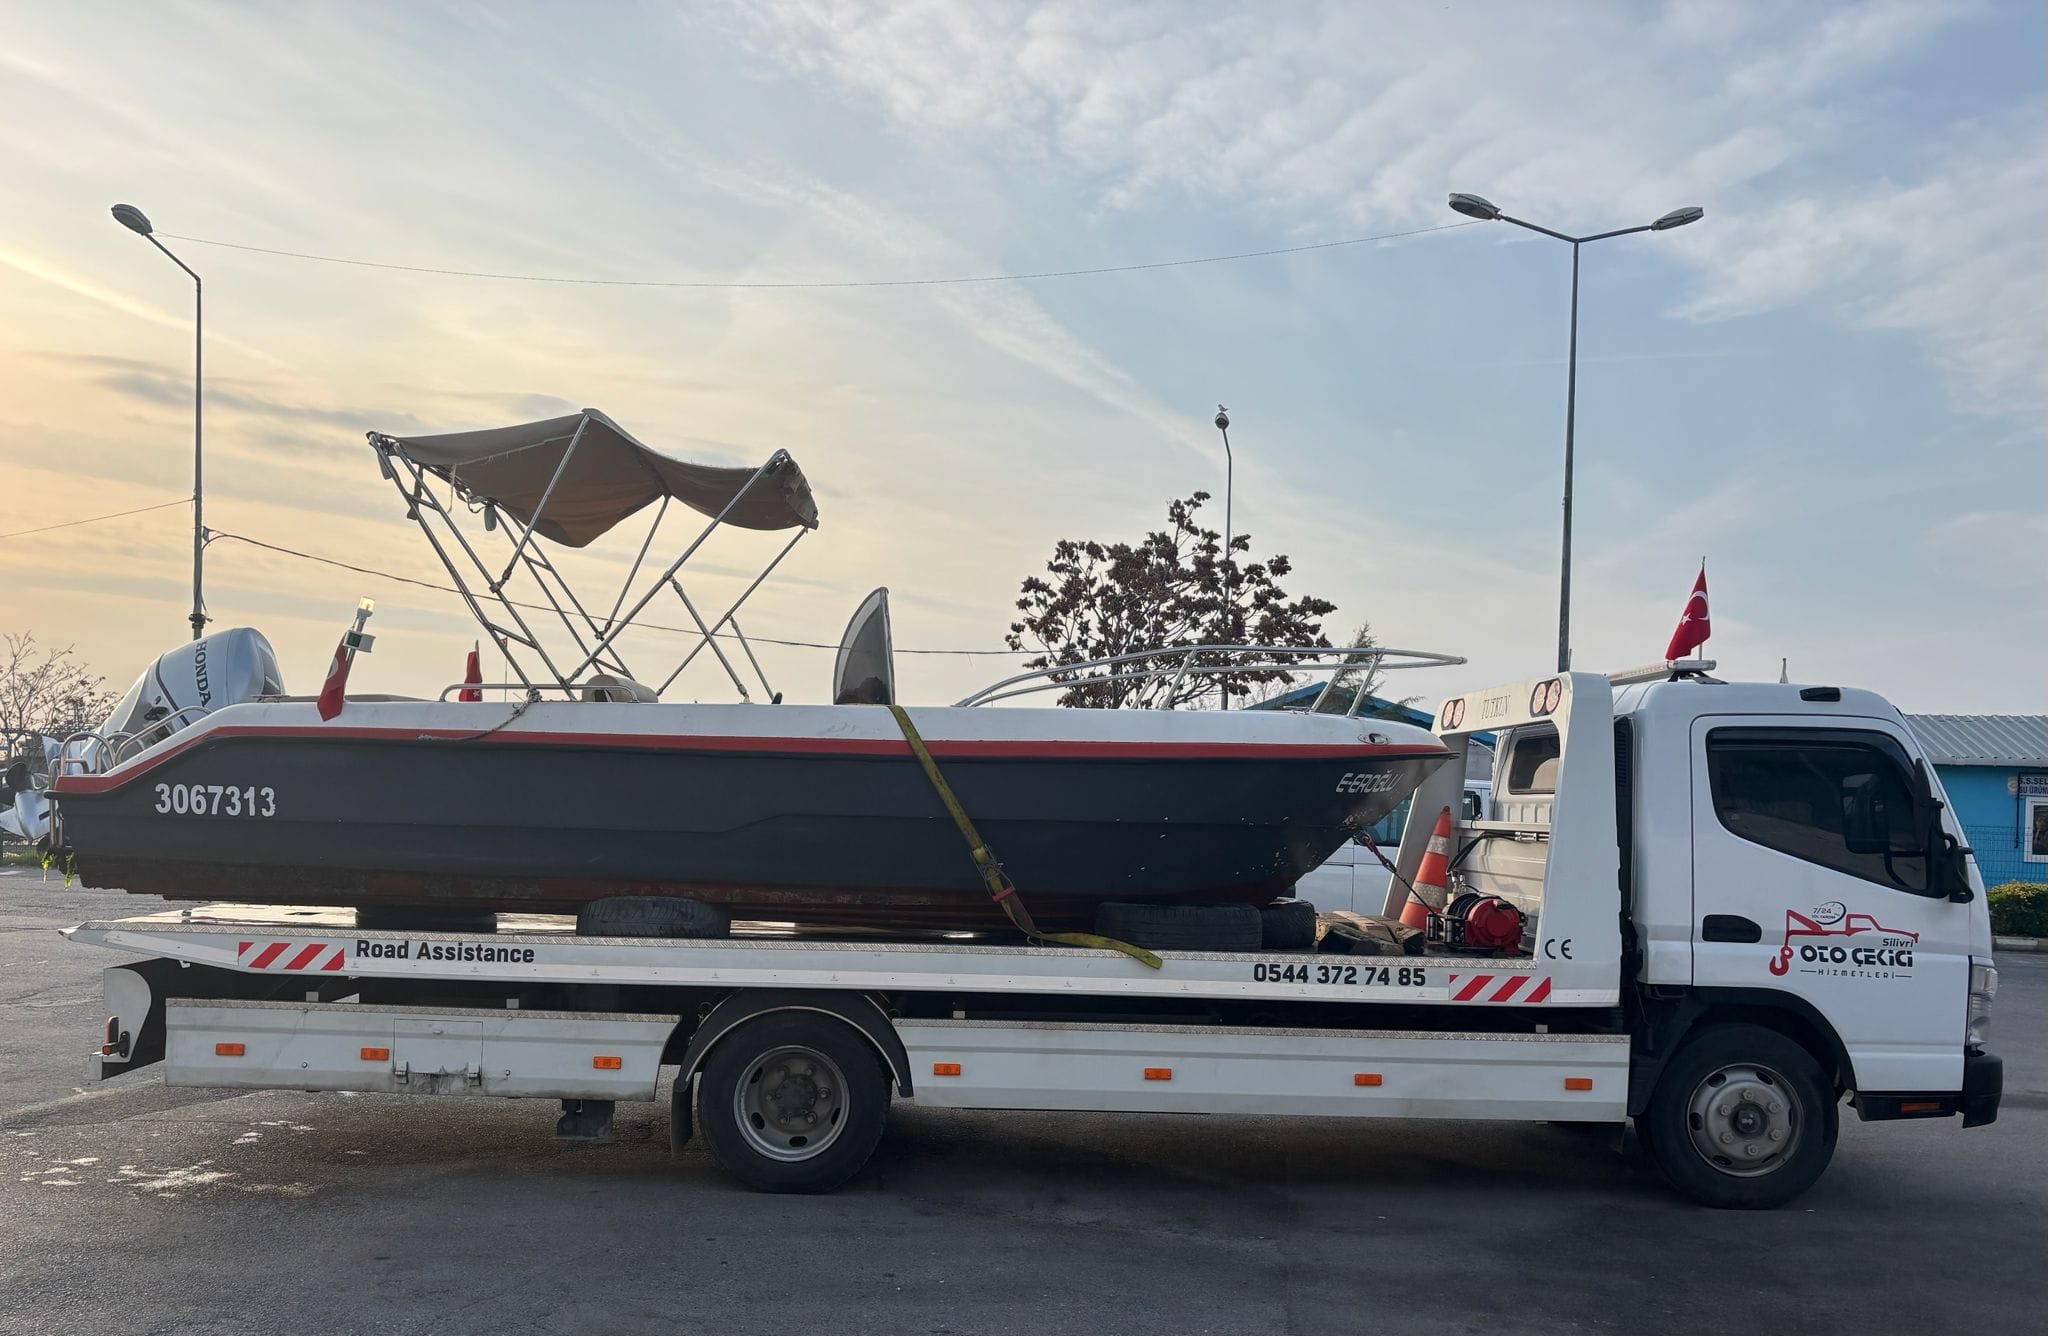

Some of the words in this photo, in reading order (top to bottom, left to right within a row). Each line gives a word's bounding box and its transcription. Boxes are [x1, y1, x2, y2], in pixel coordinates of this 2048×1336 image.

[195, 640, 211, 707] HONDA
[155, 783, 276, 817] 3067313
[356, 939, 409, 959] Road
[416, 941, 535, 963] Assistance
[1800, 945, 1847, 963] OTO
[1882, 938, 1914, 948] Silivri
[1253, 963, 1309, 983] 0544
[1316, 965, 1357, 985] 372
[1364, 966, 1391, 985] 74
[1398, 967, 1426, 986] 85
[1818, 968, 1895, 979] HİZMETLERİ
